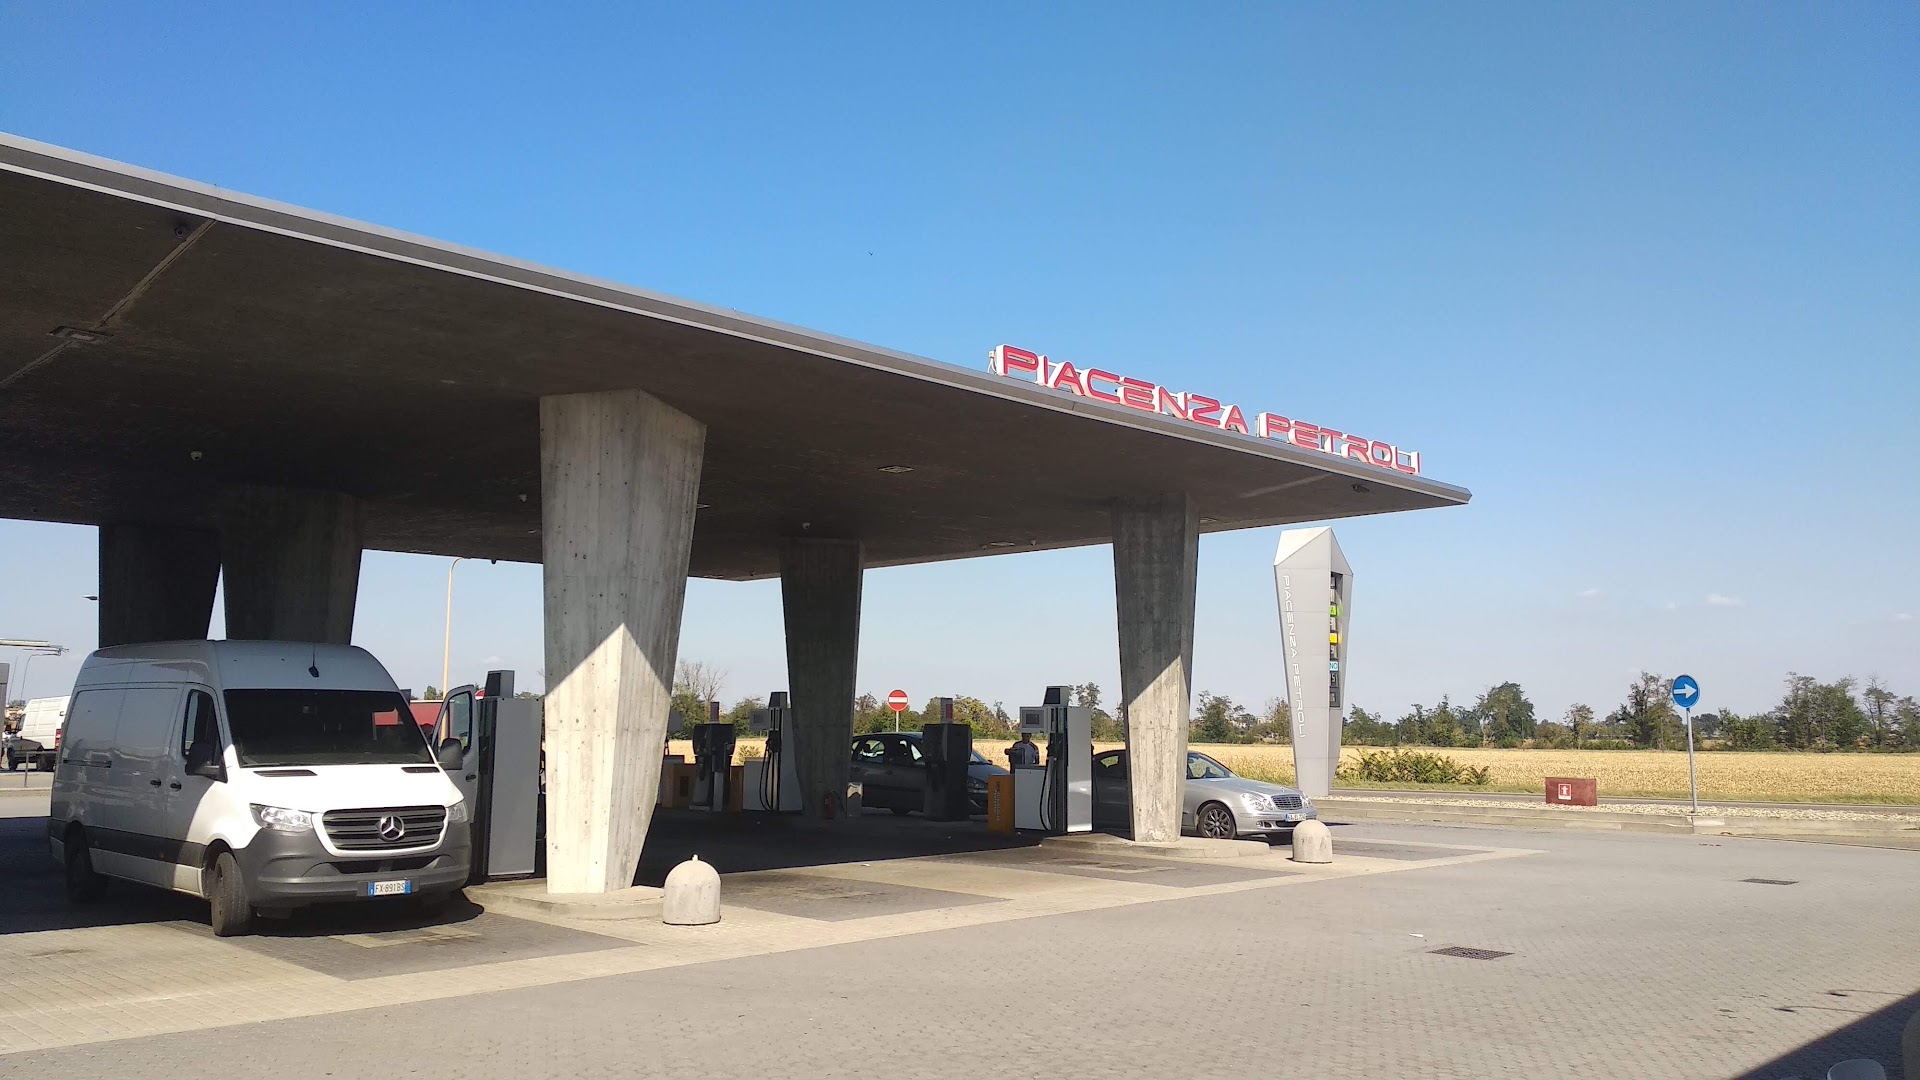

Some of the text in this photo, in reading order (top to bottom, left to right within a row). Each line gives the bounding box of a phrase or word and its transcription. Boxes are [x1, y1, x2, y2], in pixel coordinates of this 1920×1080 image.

[997, 343, 1421, 474] PIACENZA PETROLI
[1285, 575, 1306, 738] PIACENZA PETROLI
